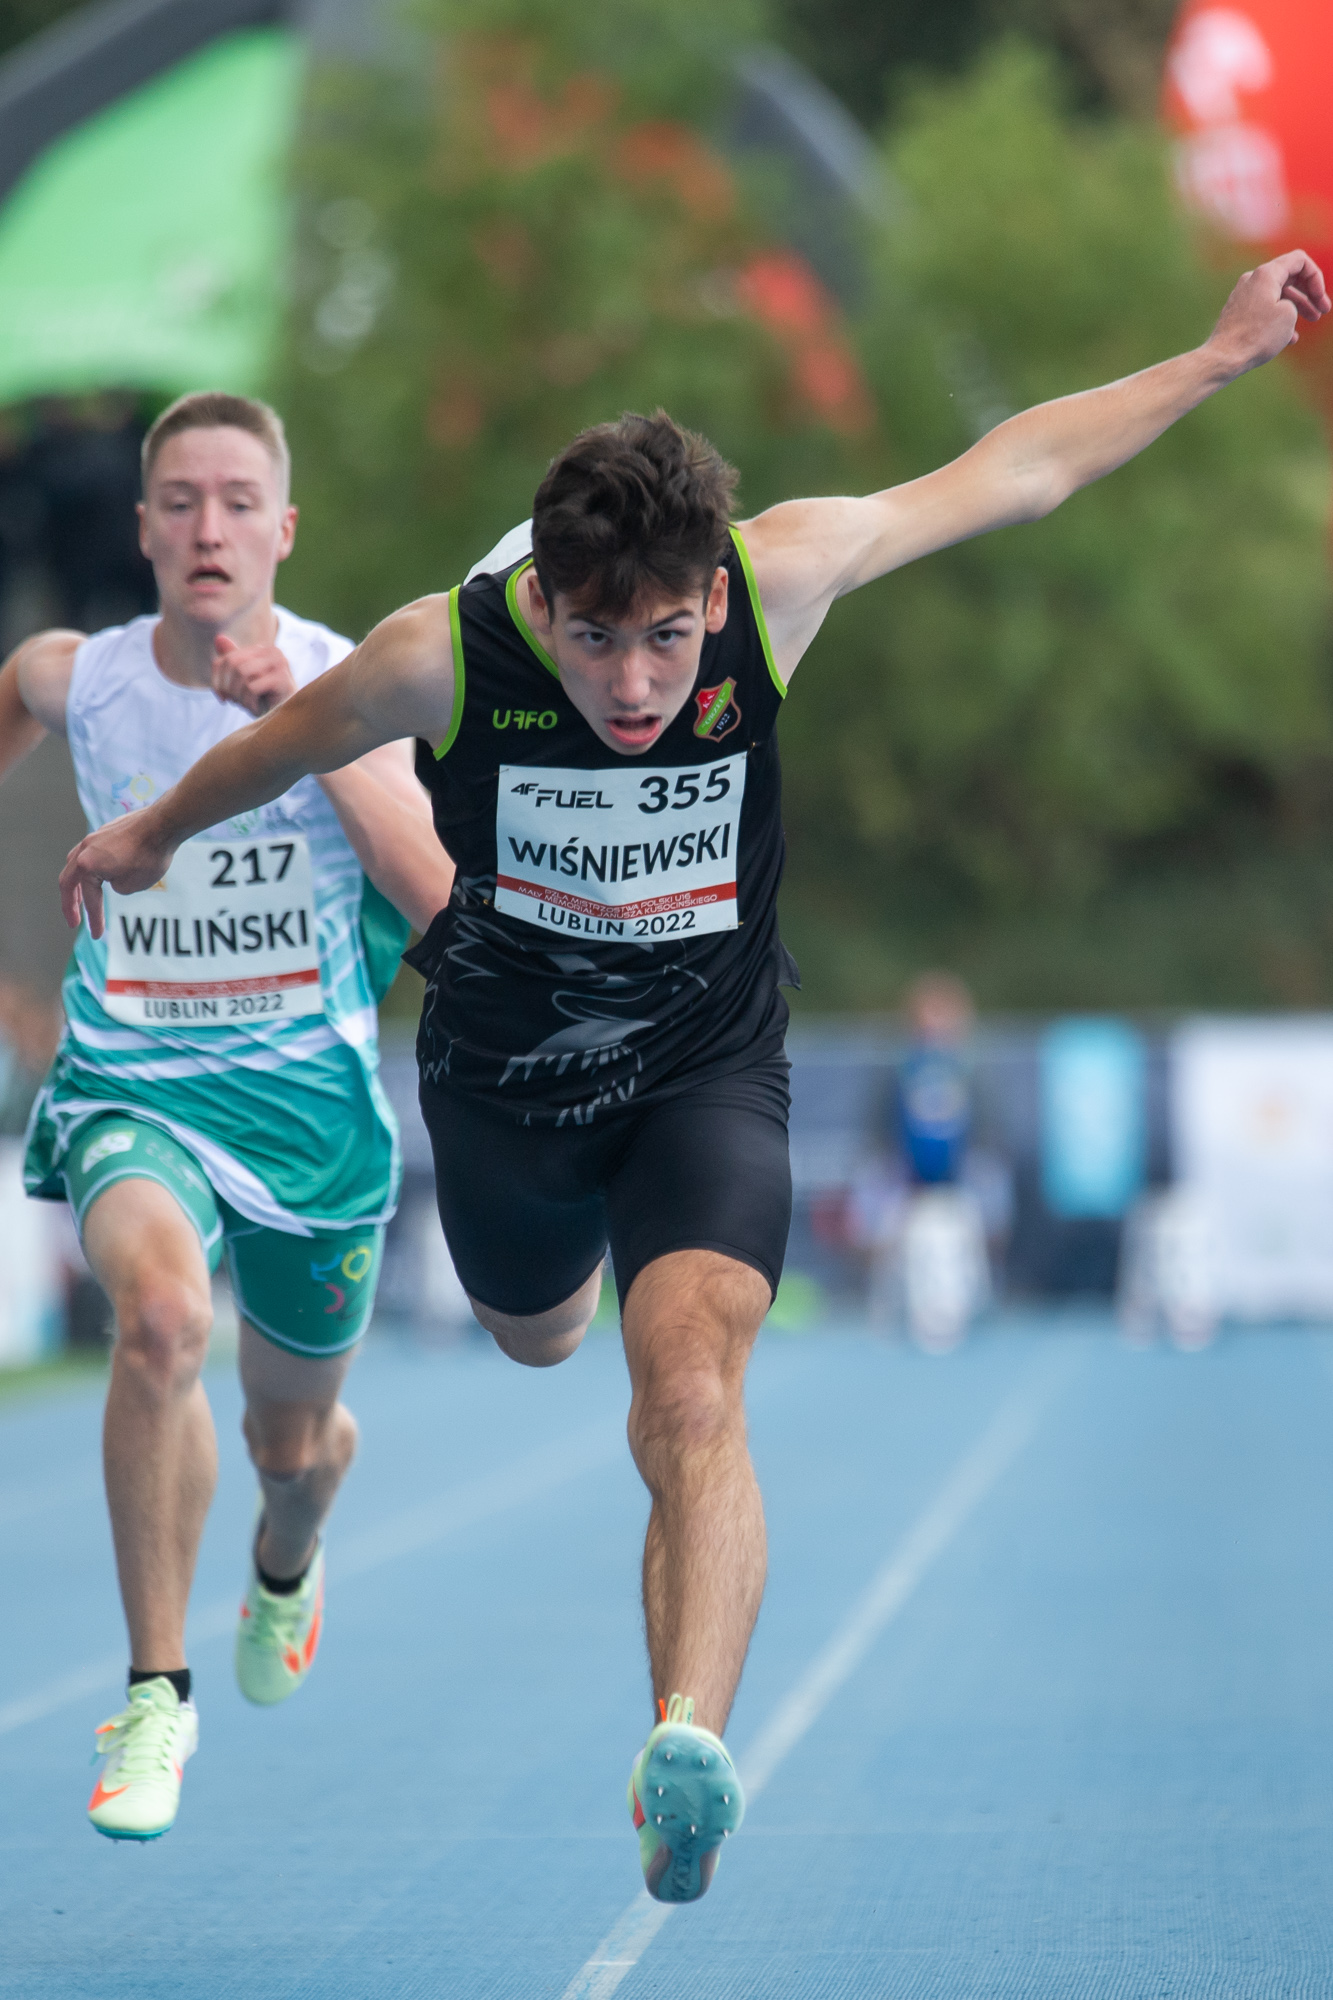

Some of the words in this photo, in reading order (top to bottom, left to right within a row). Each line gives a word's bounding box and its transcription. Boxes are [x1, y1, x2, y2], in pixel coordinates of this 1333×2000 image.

[637, 763, 731, 815] 355
[209, 843, 295, 889] 217
[508, 822, 731, 883] WIŚNIEWSKI
[537, 903, 625, 936] LUBLIN
[633, 910, 696, 937] 2022
[545, 888, 568, 901] PZLA
[571, 897, 639, 913] MISTRZOSTWA
[641, 897, 673, 908] POLSKI
[675, 893, 691, 902] U16
[596, 908, 643, 919] JANUSZA
[119, 909, 309, 957] WILIŃSKI
[144, 1000, 219, 1019] LUBLIN
[227, 994, 285, 1017] 2022
